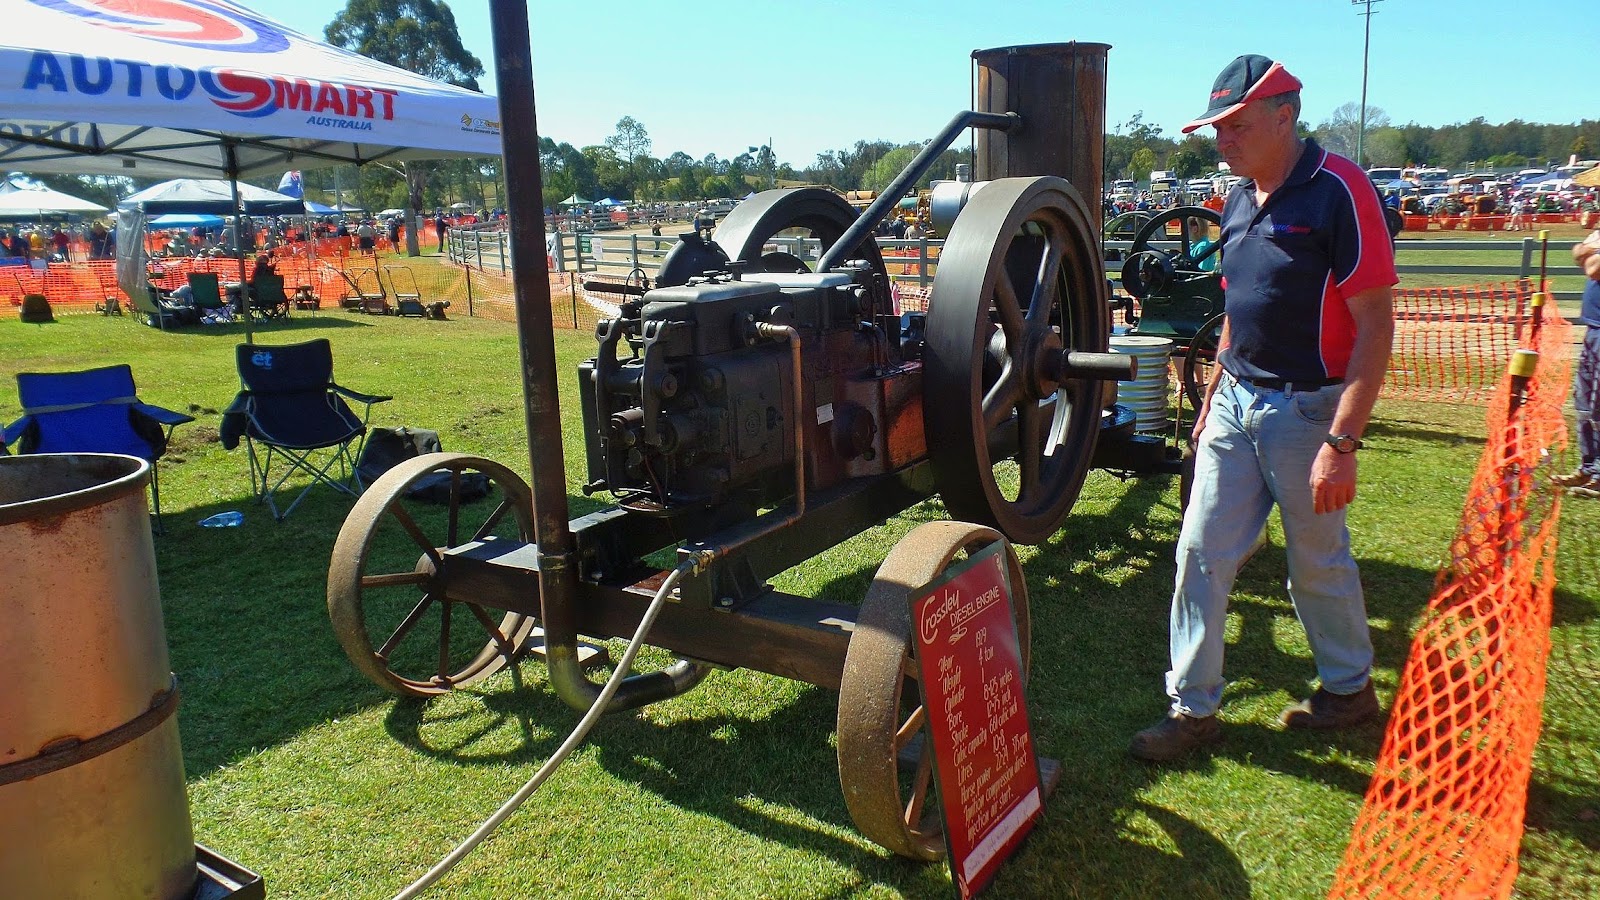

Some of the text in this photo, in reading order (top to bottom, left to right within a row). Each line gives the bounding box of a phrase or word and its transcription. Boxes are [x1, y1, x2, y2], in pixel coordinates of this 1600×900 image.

[306, 115, 373, 131] AUSTRALIA
[920, 589, 960, 645] Crossley
[950, 585, 1000, 627] DIESEL ENGINE
[943, 665, 961, 695] Weight
[945, 685, 966, 714] Cylinder
[947, 711, 962, 731] Bore
[951, 721, 969, 749] Stroke
[954, 743, 967, 767] Cubic
[968, 728, 987, 755] capacity
[958, 762, 973, 787] Litres
[961, 782, 976, 804] Horse
[977, 766, 991, 796] power
[986, 765, 1014, 801] compression
[1014, 750, 1027, 773] direct
